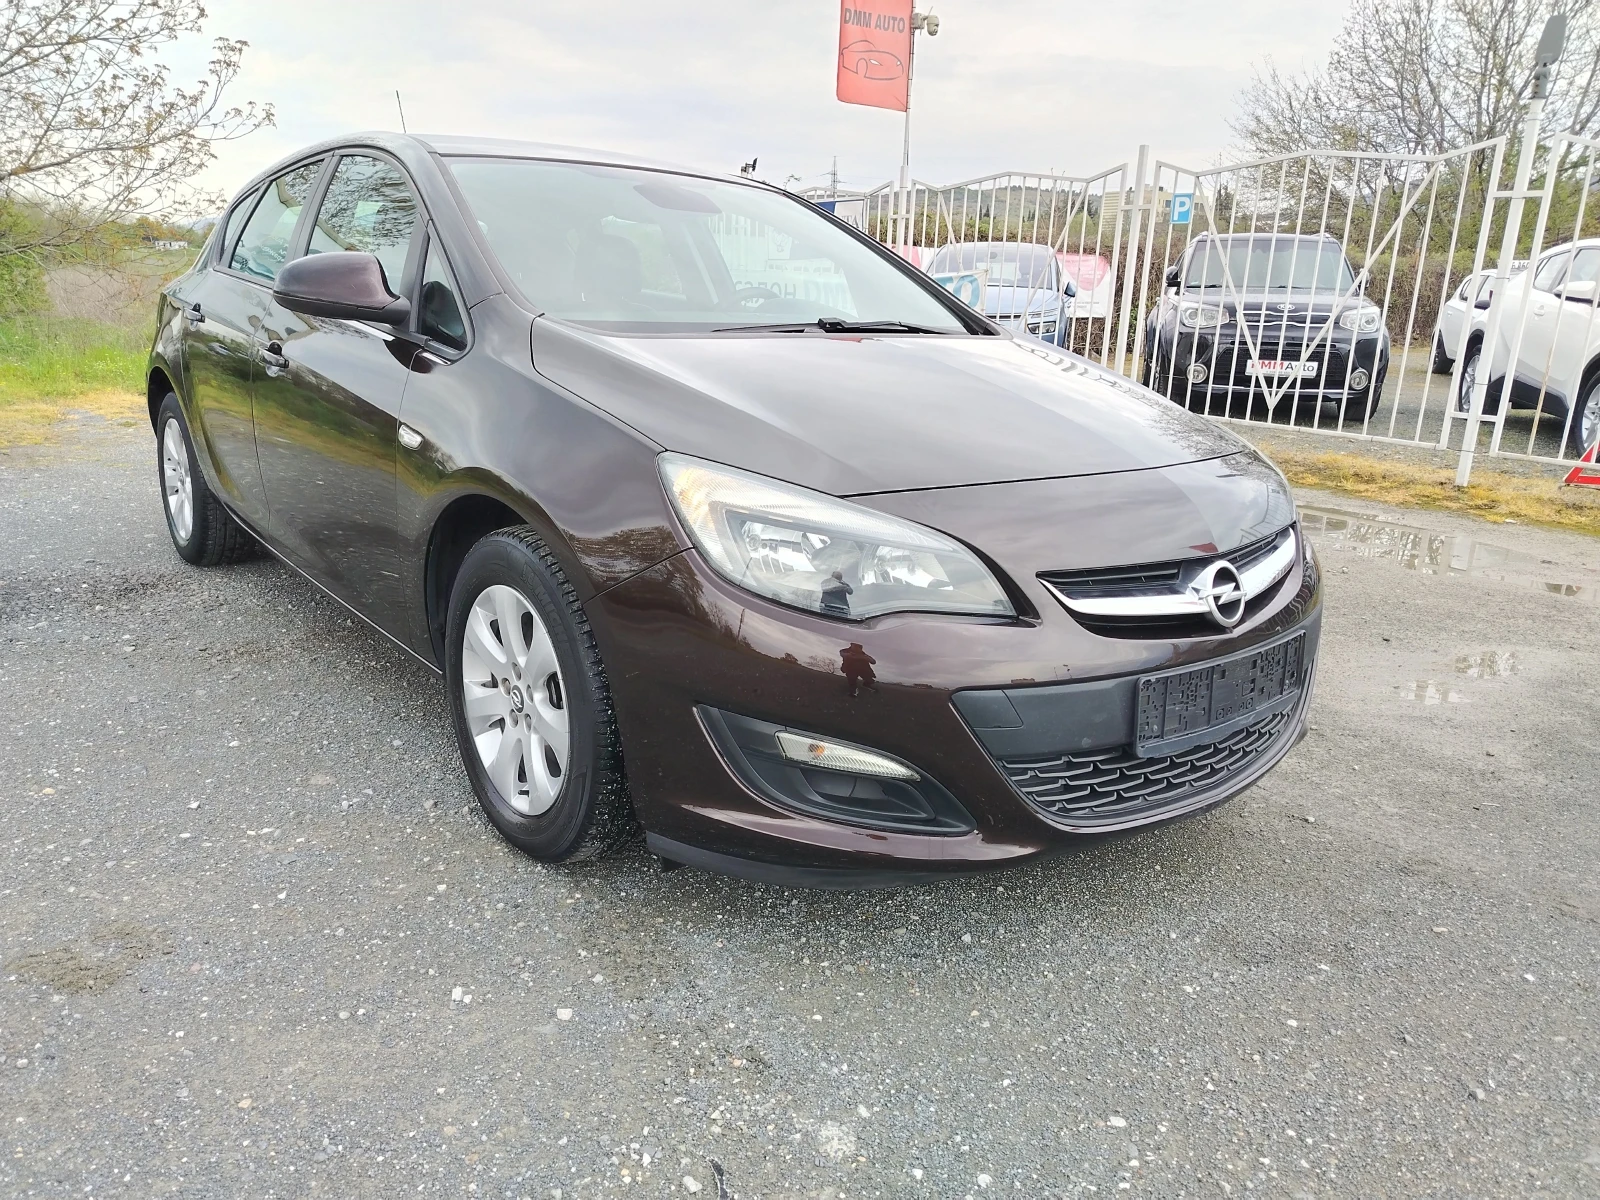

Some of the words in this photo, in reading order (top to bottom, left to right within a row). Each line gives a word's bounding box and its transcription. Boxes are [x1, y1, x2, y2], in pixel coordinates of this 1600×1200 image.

[844, 8, 872, 28] DMM
[875, 14, 905, 33] AUTO
[1173, 197, 1191, 221] P
